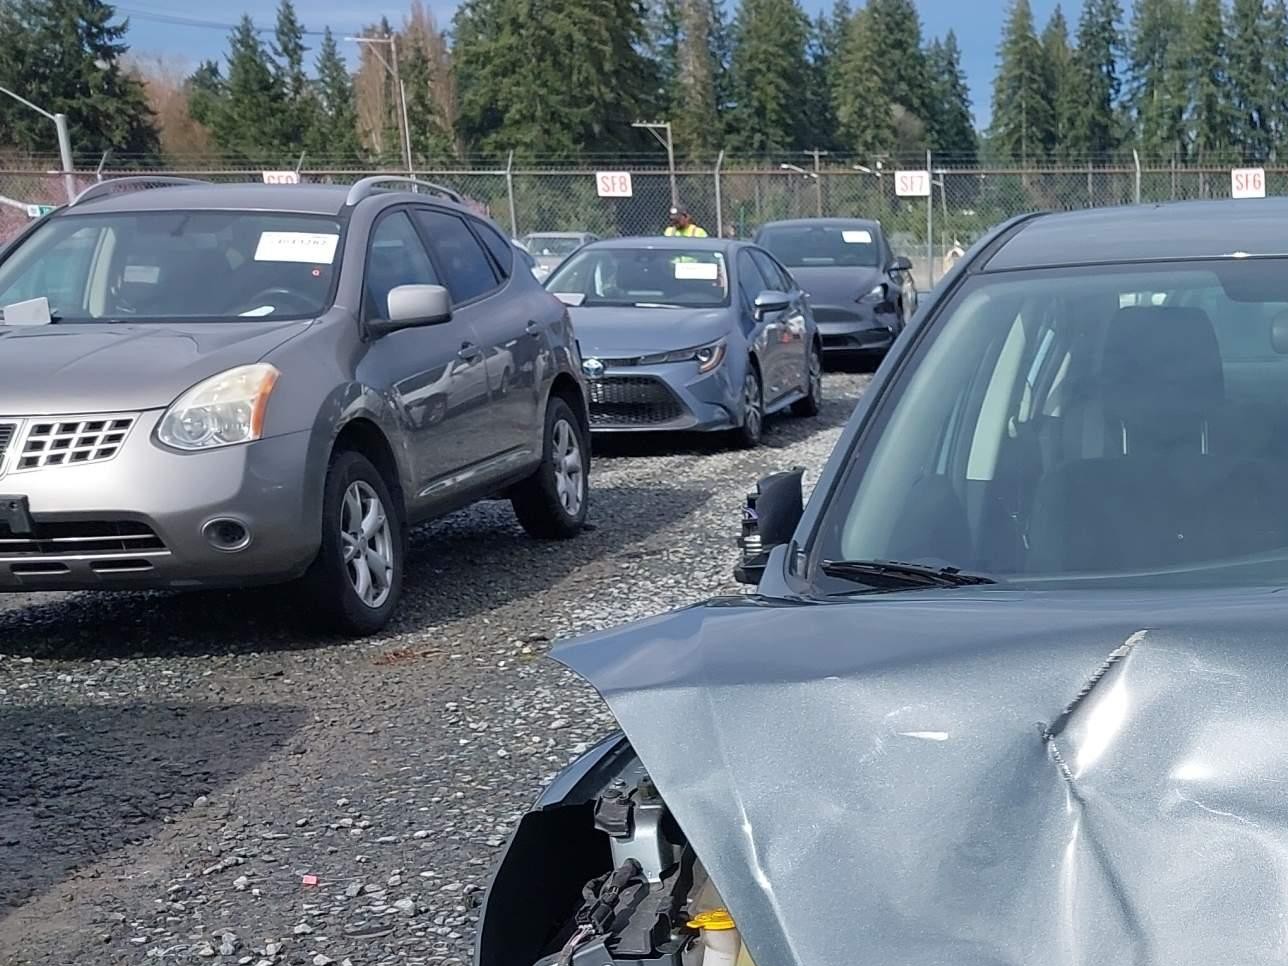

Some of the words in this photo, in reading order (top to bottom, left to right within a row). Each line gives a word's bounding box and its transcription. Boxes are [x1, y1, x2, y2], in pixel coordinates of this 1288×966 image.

[600, 175, 628, 193] SF8
[900, 175, 924, 193] SF7
[1235, 173, 1262, 192] SF6
